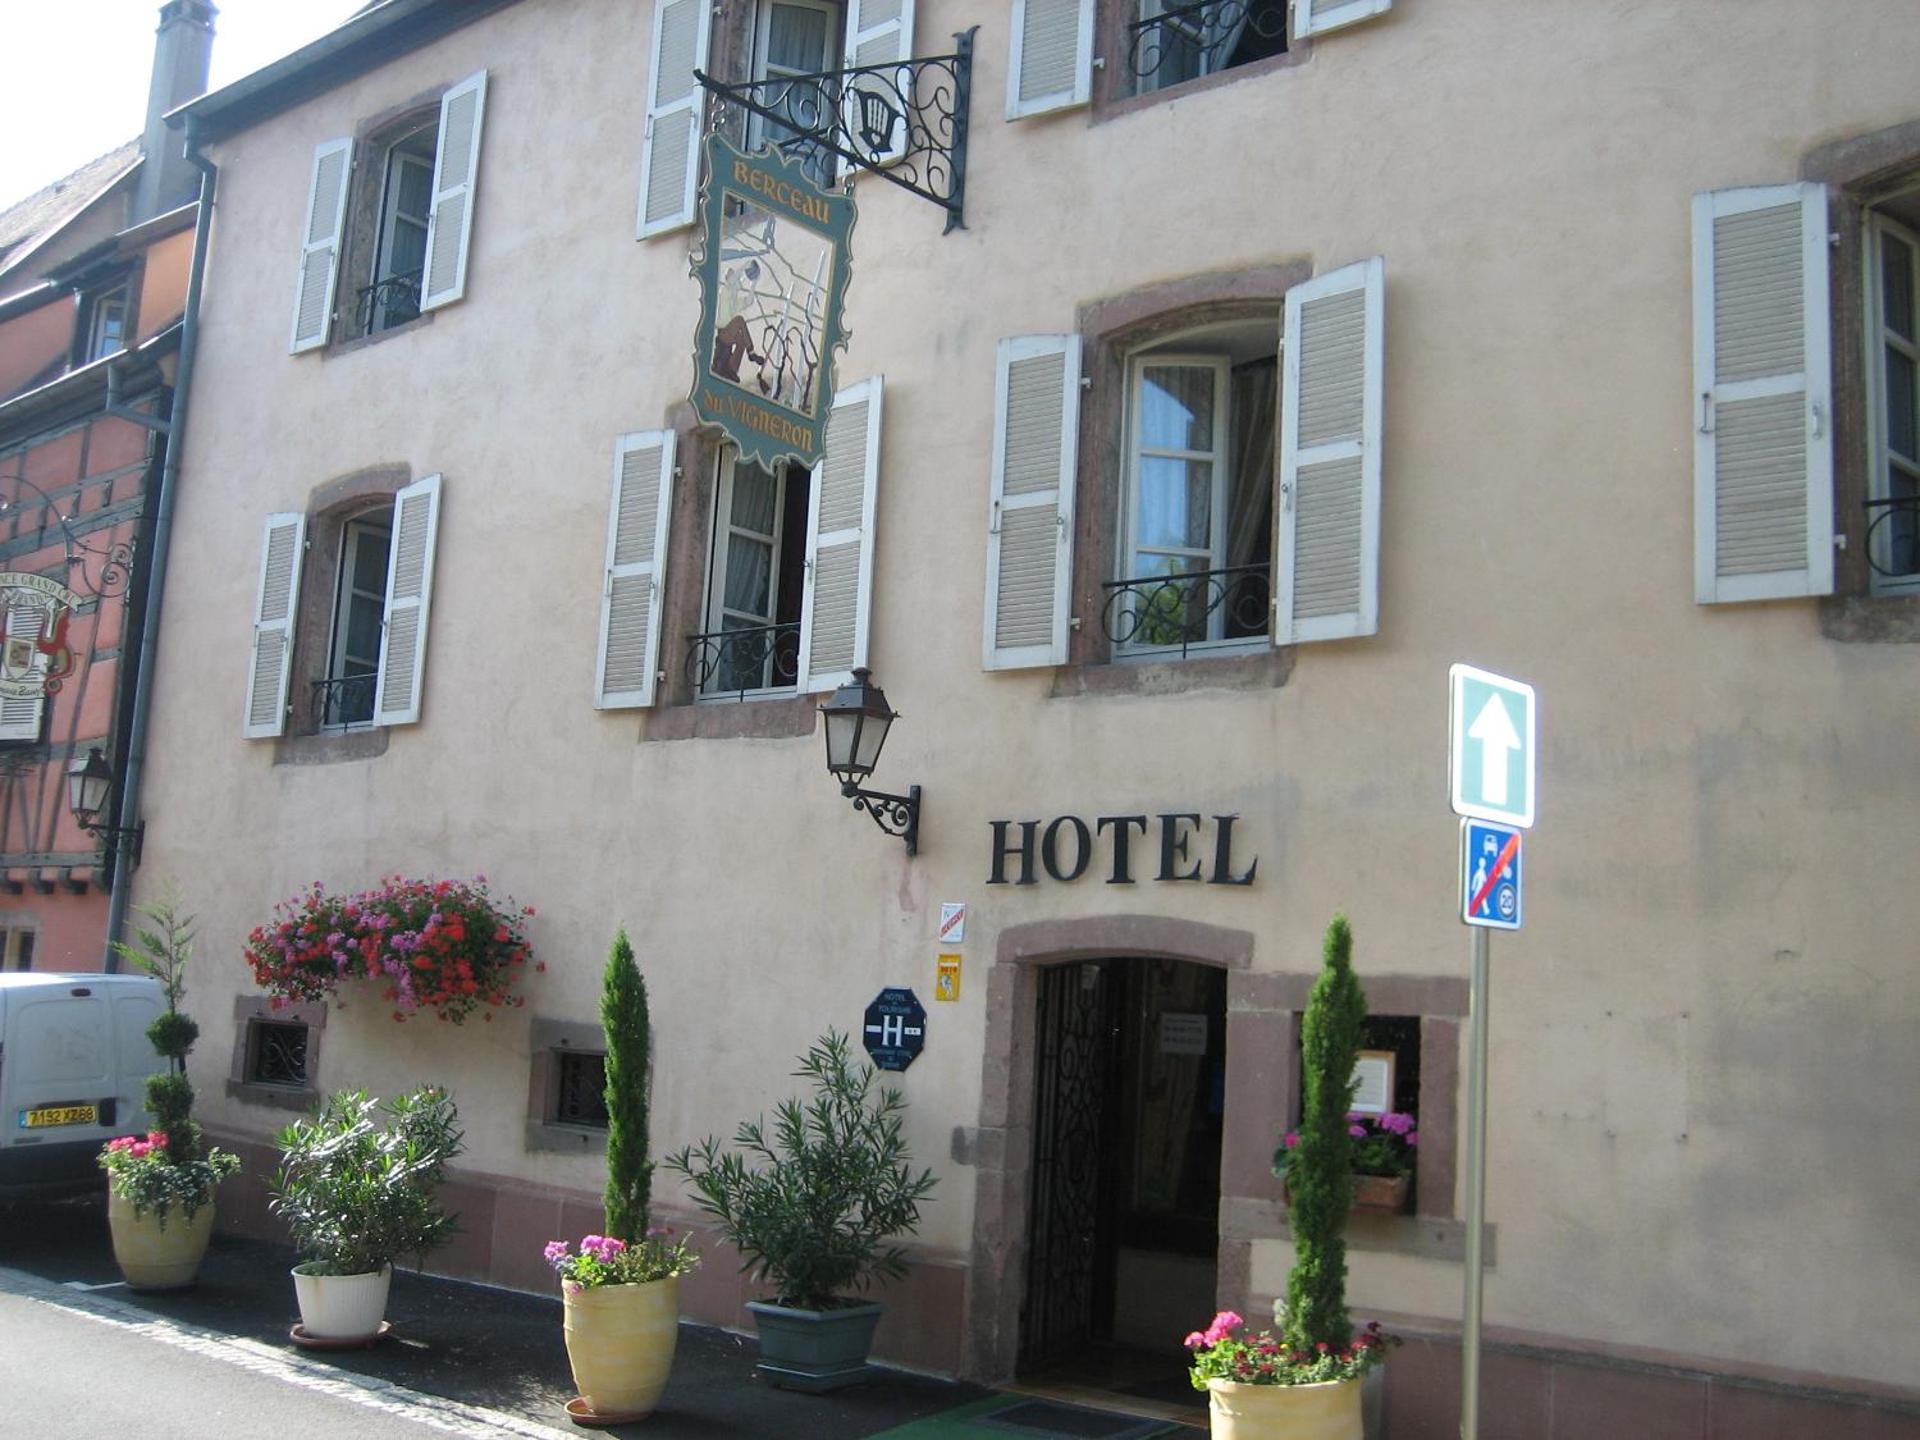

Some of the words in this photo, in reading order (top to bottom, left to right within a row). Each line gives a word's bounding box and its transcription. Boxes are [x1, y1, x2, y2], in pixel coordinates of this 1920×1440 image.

[733, 160, 830, 224] BERCEAU
[986, 812, 1258, 885] HOTEL
[881, 1014, 904, 1048] H
